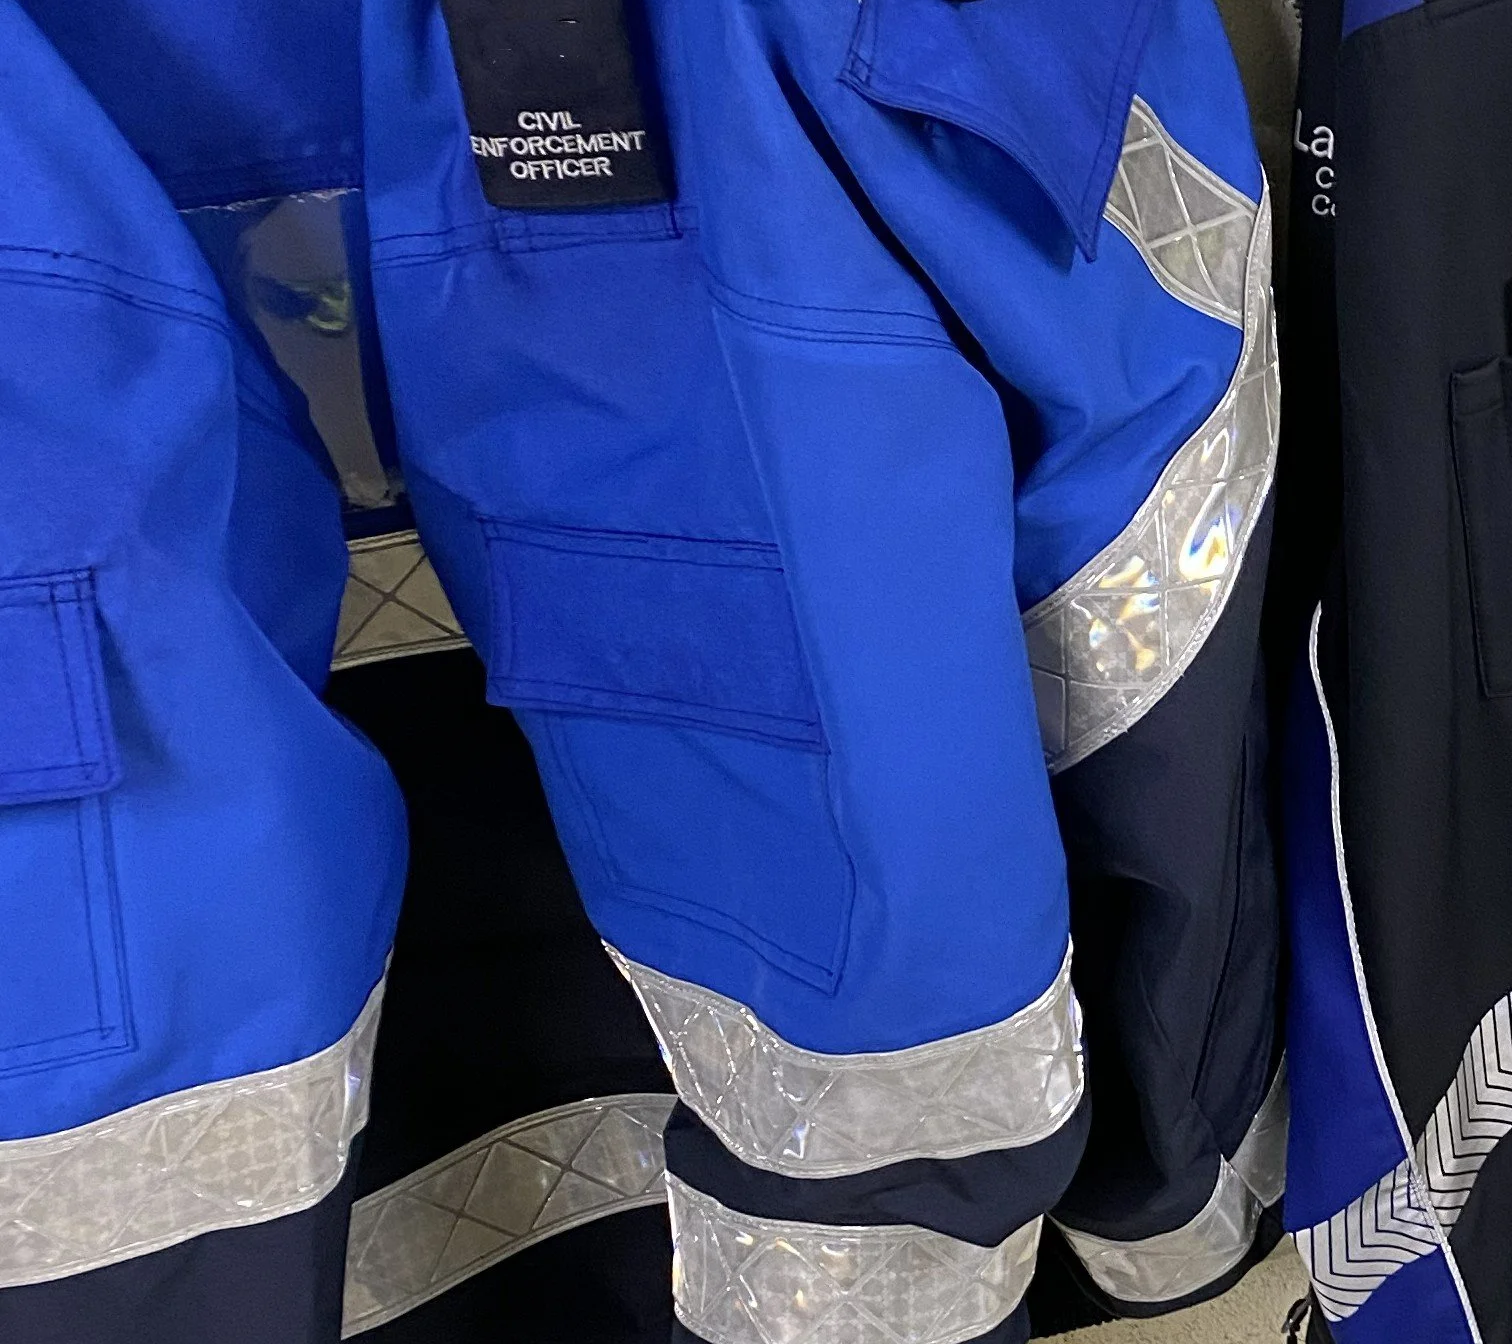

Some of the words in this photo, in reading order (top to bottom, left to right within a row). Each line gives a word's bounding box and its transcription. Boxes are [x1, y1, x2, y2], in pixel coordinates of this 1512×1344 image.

[517, 111, 583, 131] CIVIL
[470, 131, 646, 157] ENFORCEMENT
[509, 157, 613, 180] OFFICER
